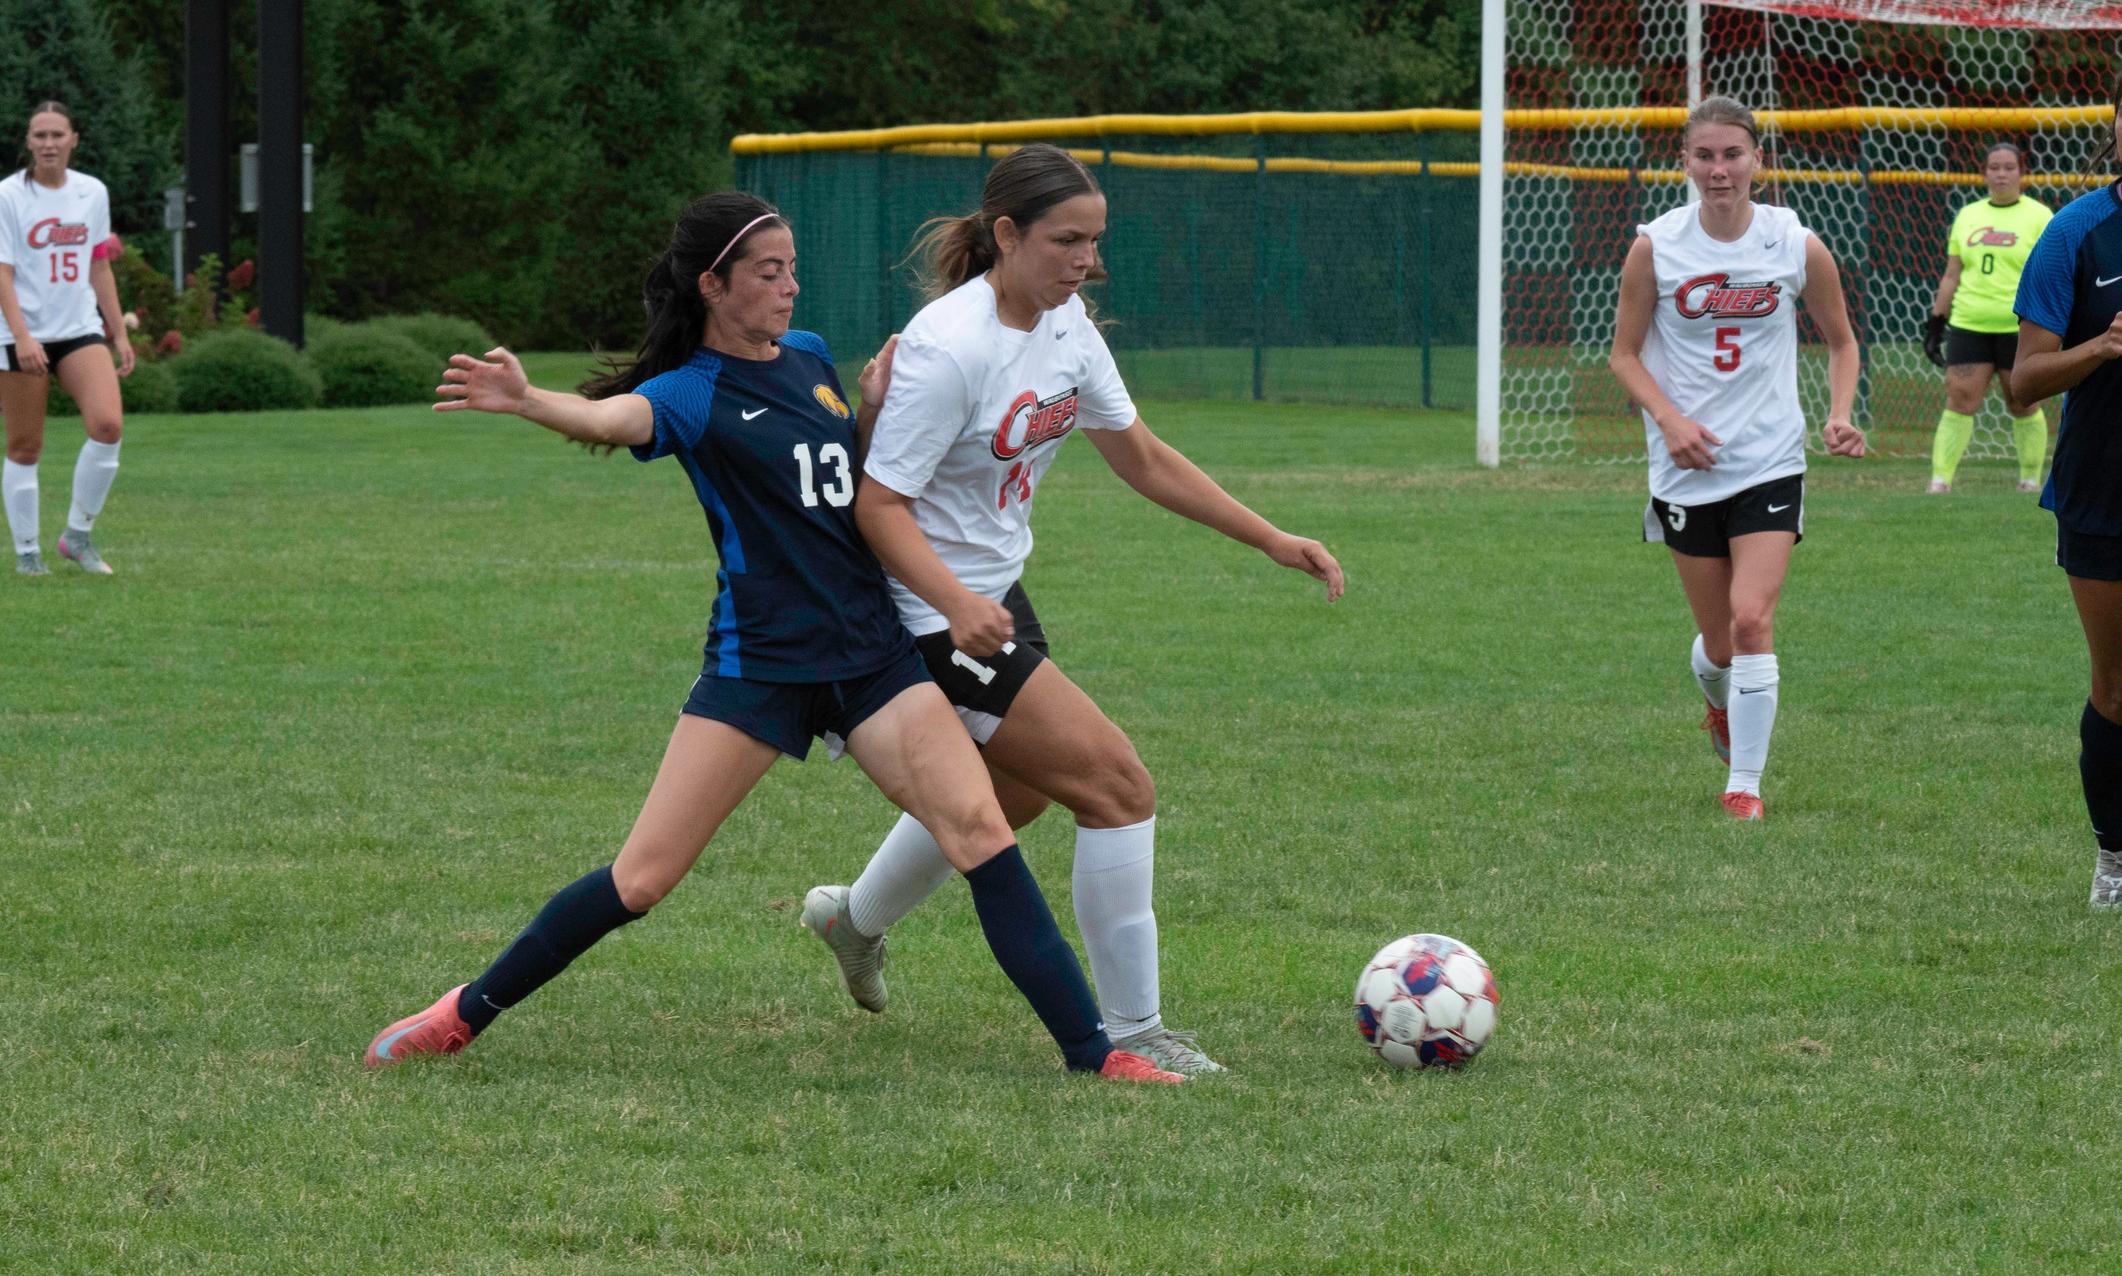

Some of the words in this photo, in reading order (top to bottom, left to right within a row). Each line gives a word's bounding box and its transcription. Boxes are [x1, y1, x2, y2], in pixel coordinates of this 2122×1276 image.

[49, 252, 78, 283] 15
[1982, 253, 1995, 275] 0
[1675, 272, 1782, 319] CHIEFS
[1713, 327, 1741, 372] 5
[793, 443, 855, 507] 13
